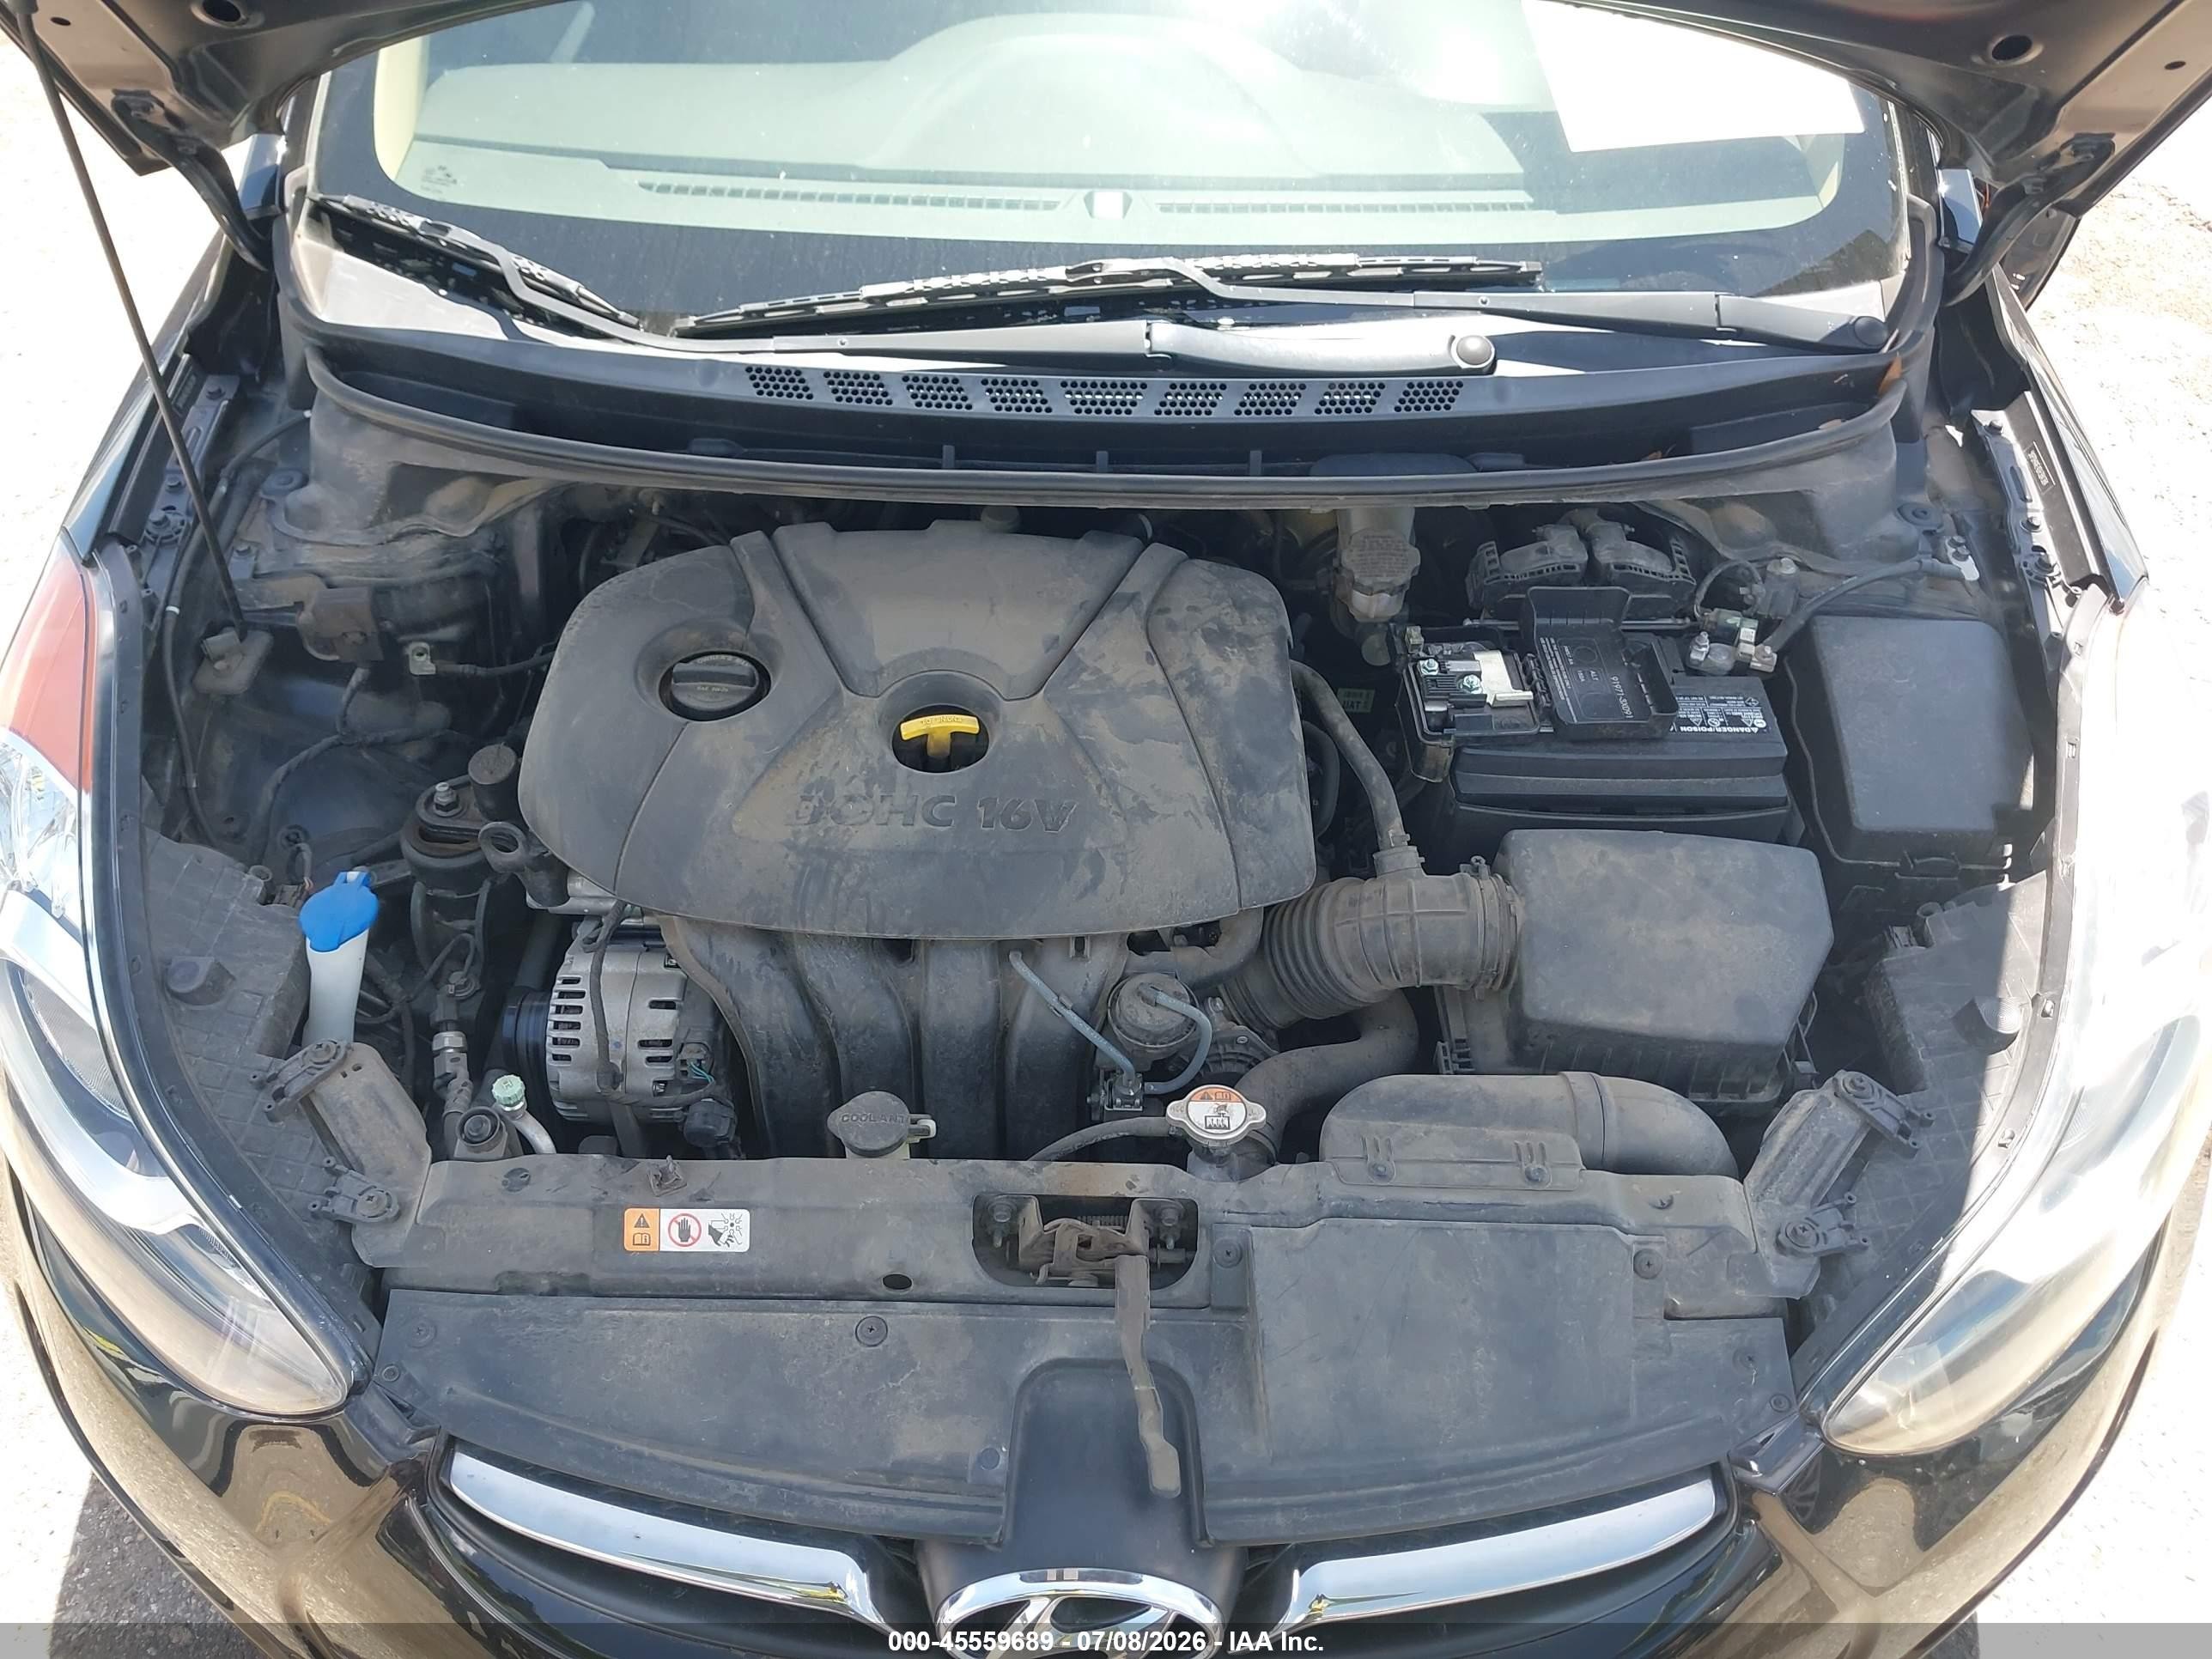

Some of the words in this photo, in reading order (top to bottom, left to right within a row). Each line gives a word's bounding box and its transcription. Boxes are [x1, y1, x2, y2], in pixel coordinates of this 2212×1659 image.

[785, 793, 957, 829] DOHC
[976, 796, 1078, 834] 16V
[841, 1112, 906, 1124] COOLANT
